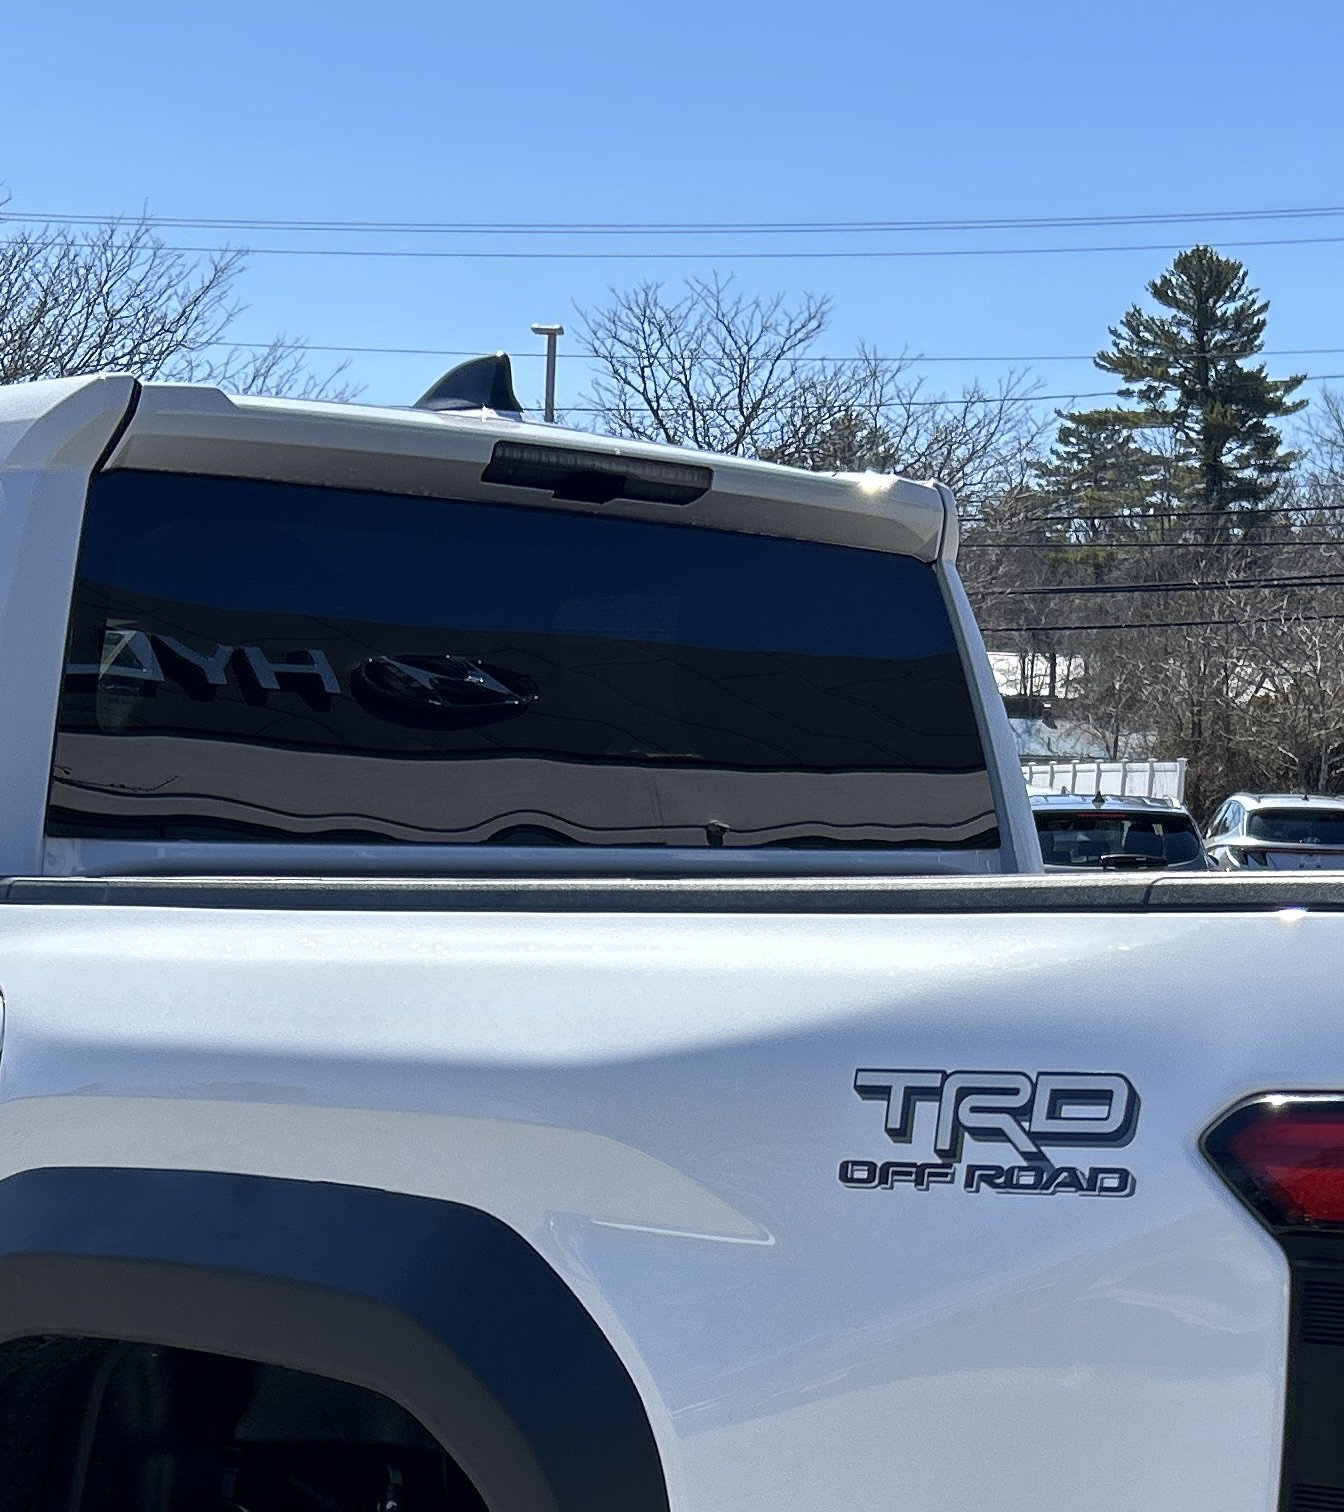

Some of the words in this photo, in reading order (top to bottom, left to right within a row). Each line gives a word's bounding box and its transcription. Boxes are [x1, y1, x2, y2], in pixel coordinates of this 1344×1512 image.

[853, 1068, 1141, 1164] TRD
[839, 1160, 956, 1191] OFF
[963, 1164, 1136, 1197] ROAD
